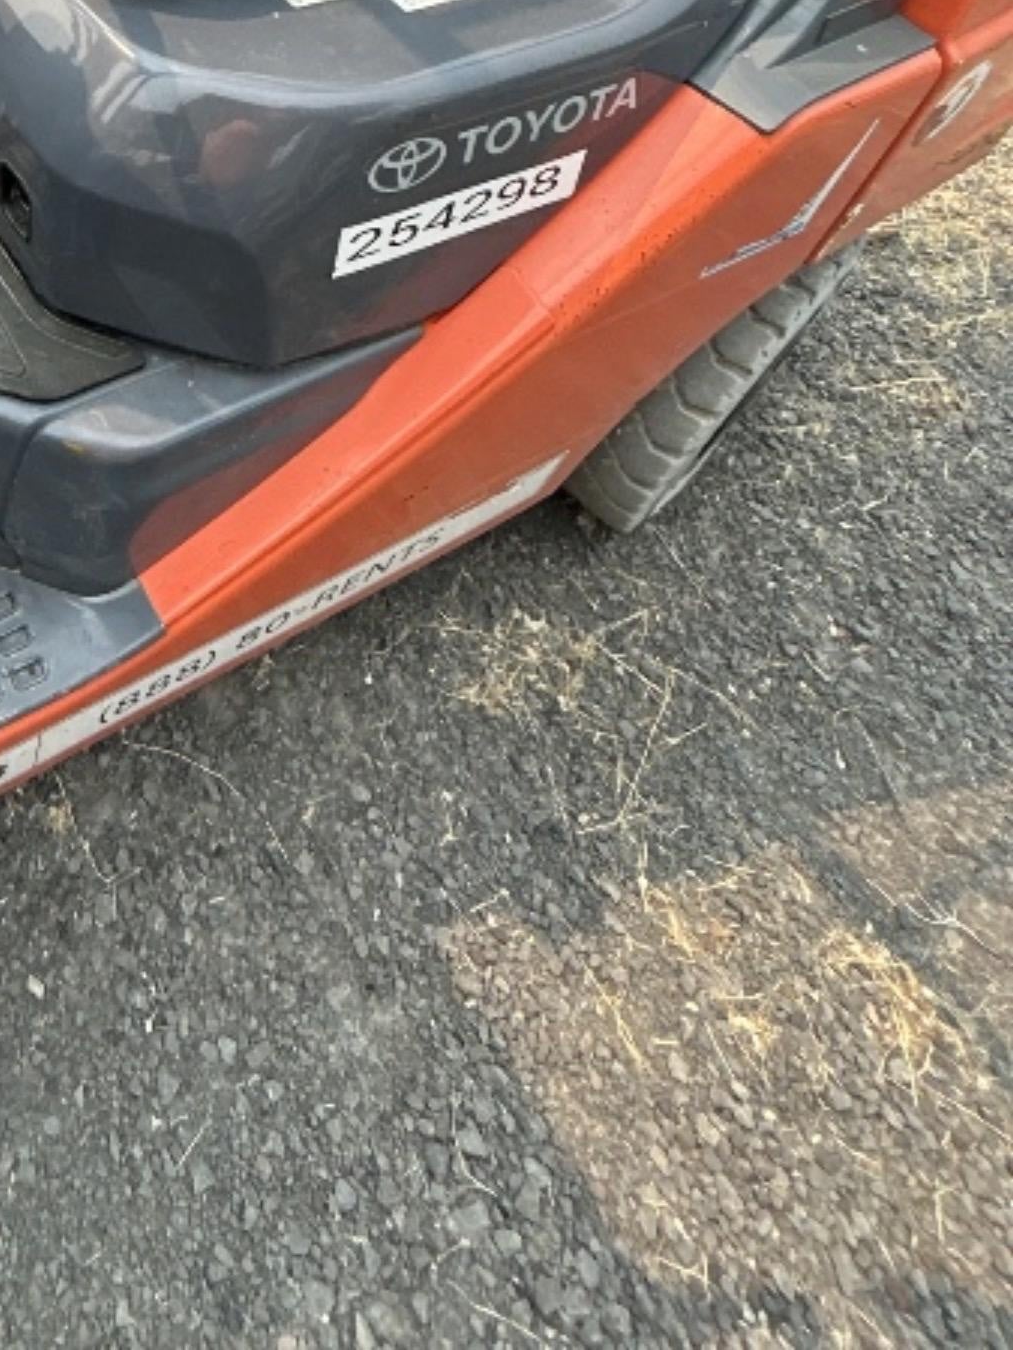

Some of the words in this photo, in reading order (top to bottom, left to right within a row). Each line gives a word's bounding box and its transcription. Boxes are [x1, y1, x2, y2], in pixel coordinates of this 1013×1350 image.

[458, 77, 638, 163] TOYOTA
[346, 166, 562, 262] 254298
[99, 650, 216, 724] (888)
[235, 526, 446, 649] 80-RENTS
